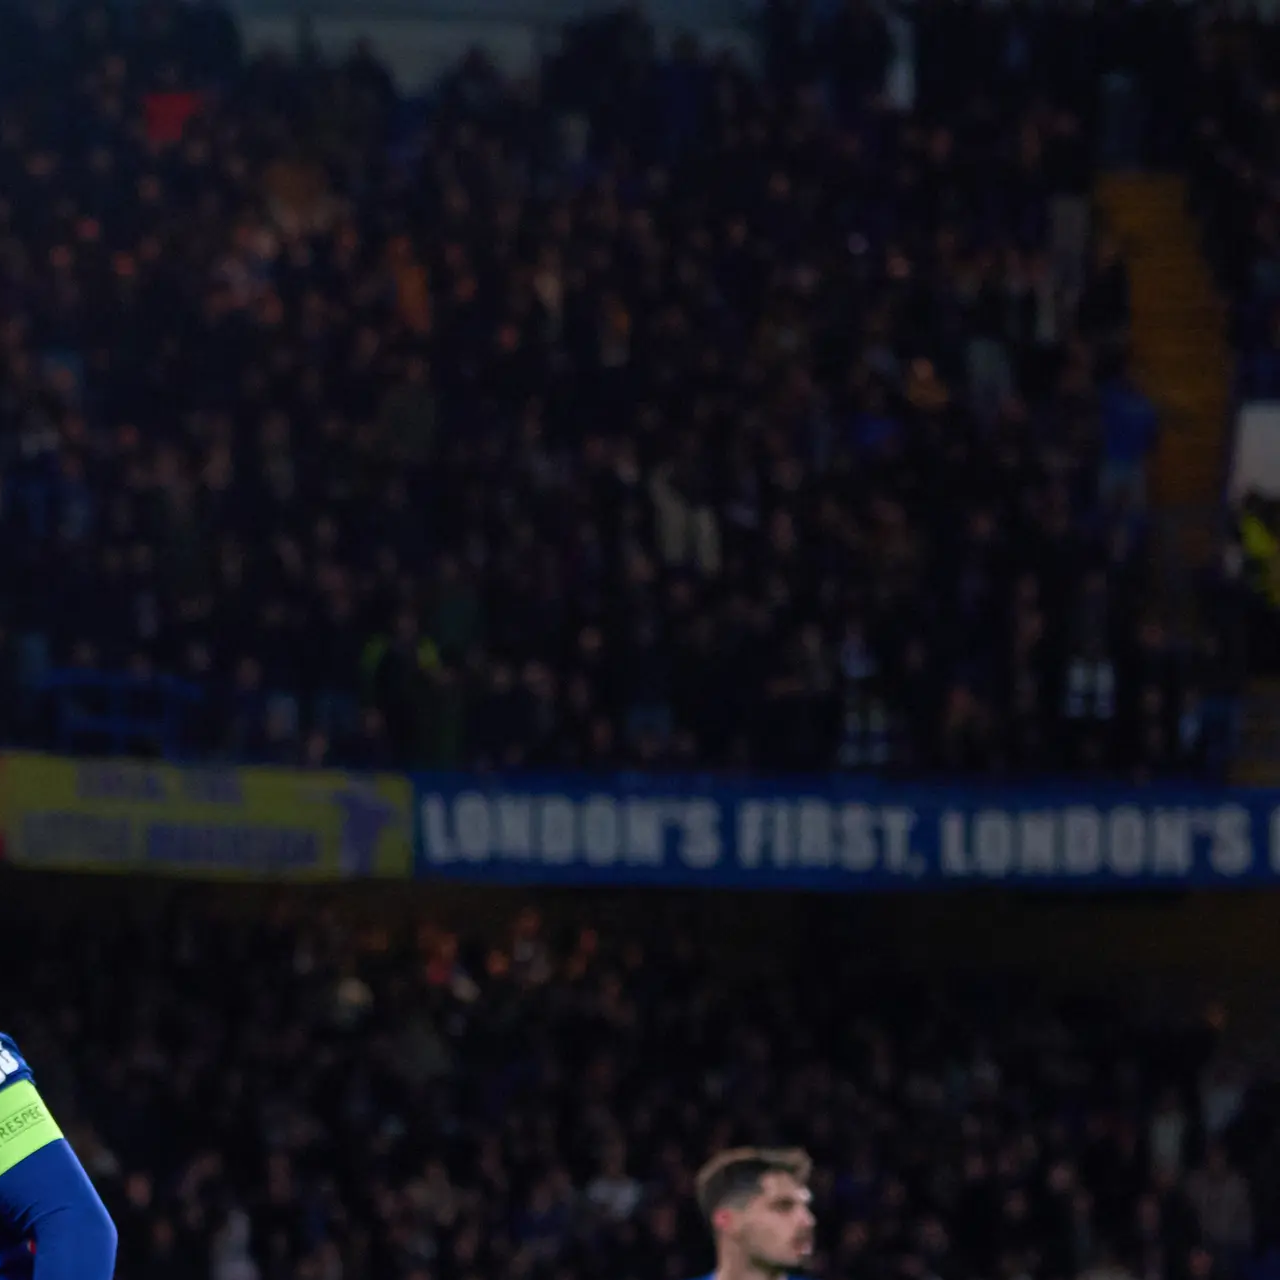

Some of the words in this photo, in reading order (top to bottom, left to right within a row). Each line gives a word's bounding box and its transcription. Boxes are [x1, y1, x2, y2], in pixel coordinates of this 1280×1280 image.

[423, 793, 722, 870] LONDON'S
[737, 799, 927, 878] FIRST,
[942, 803, 1252, 878] LONDON'S
